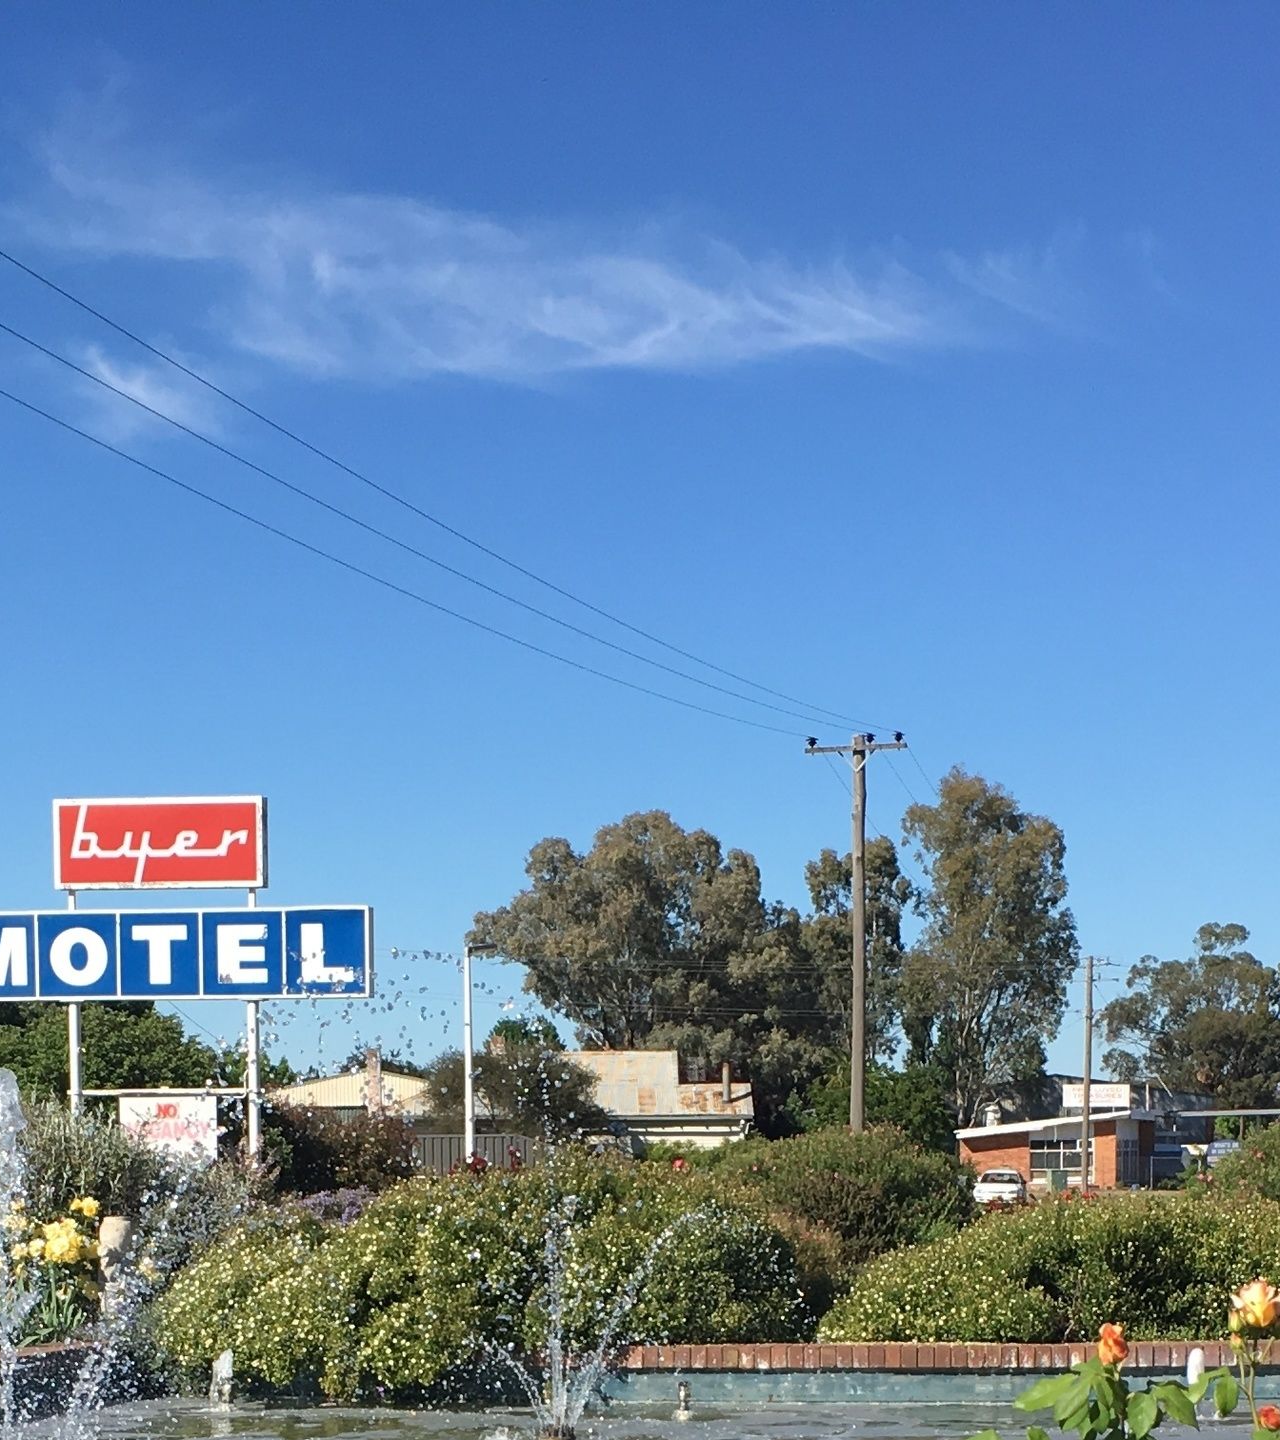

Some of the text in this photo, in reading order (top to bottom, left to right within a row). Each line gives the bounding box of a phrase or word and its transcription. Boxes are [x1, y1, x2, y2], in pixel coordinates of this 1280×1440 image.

[71, 804, 248, 885] byer
[156, 1103, 178, 1119] NO
[126, 1120, 211, 1140] VCANCY
